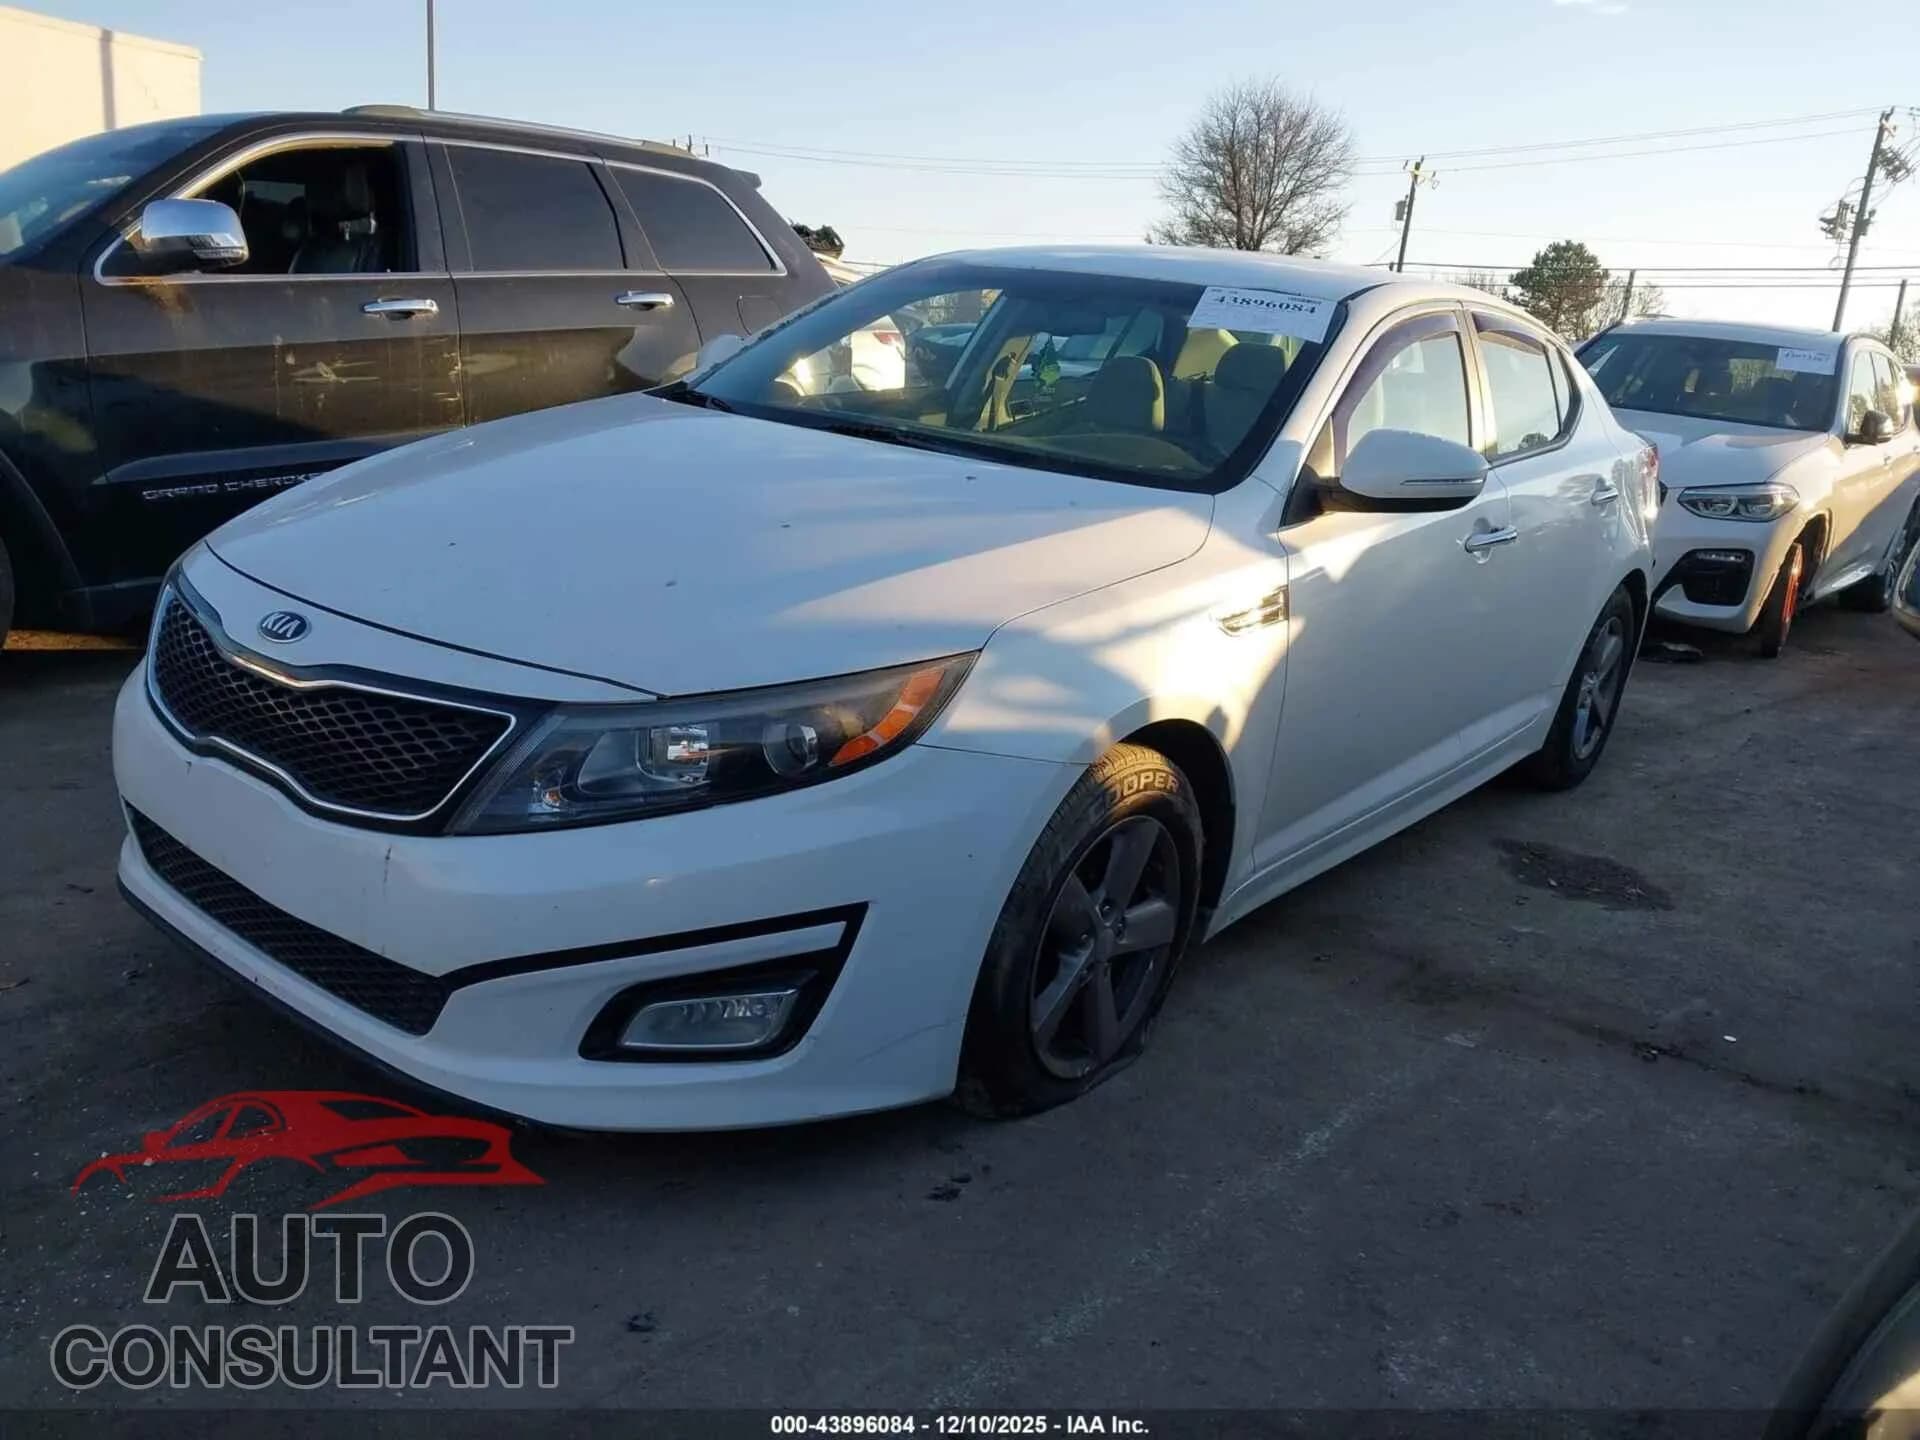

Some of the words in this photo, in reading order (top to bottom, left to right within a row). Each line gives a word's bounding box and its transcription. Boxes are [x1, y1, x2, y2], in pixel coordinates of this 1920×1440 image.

[1215, 295, 1316, 314] 43896084
[142, 483, 218, 500] GRAND
[262, 613, 301, 638] KIA
